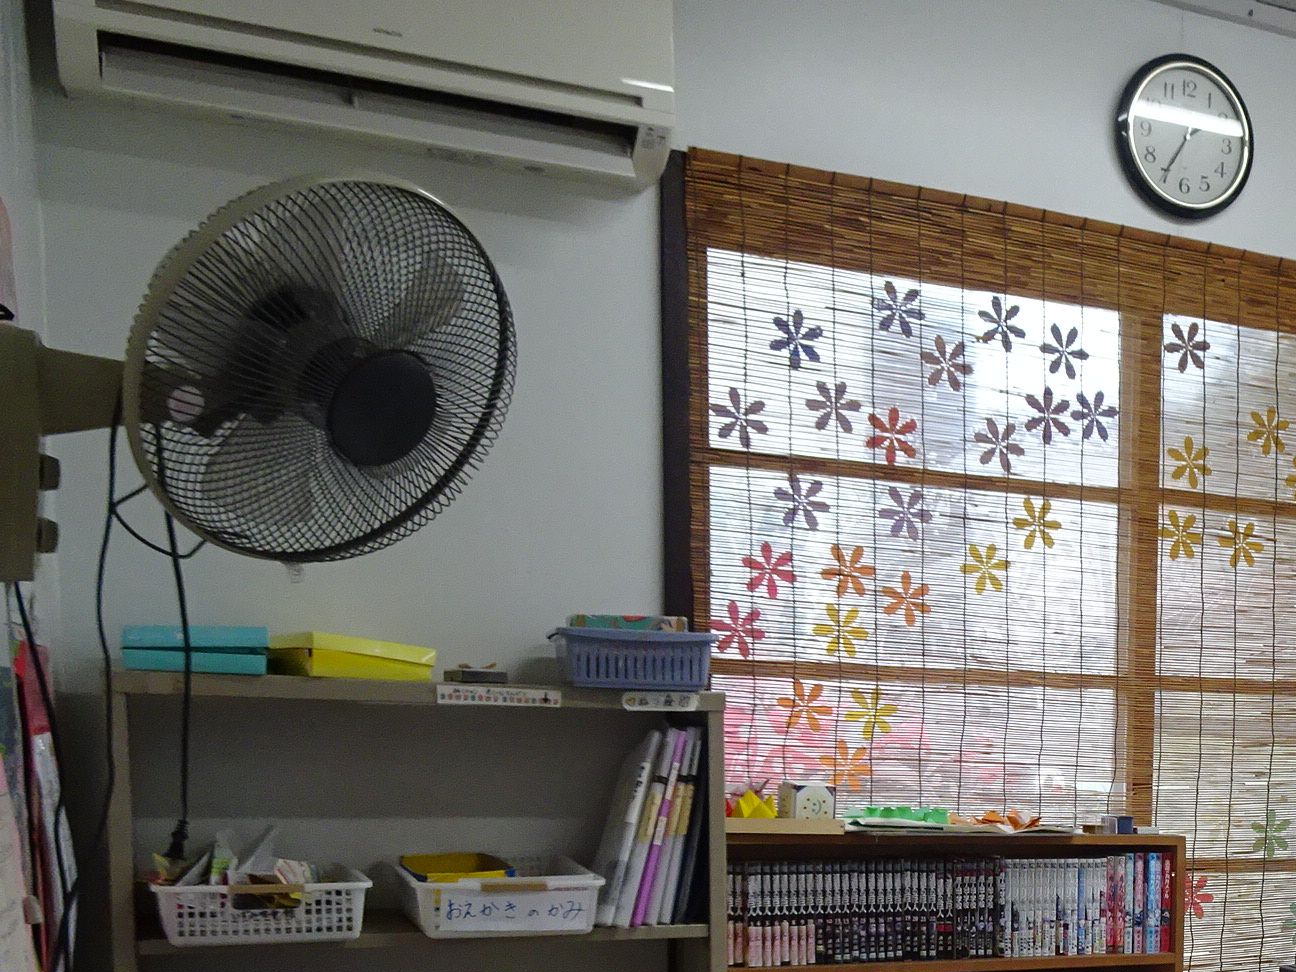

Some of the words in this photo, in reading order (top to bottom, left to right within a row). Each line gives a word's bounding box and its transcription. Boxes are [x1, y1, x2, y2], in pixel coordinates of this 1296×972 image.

[1163, 81, 1175, 100] 11
[1183, 79, 1197, 98] 12
[1140, 120, 1152, 137] 9
[1144, 146, 1157, 163] 8
[1220, 138, 1232, 155] 3
[1213, 161, 1227, 178] 4
[1178, 177, 1191, 194] 6
[1198, 175, 1210, 192] 5
